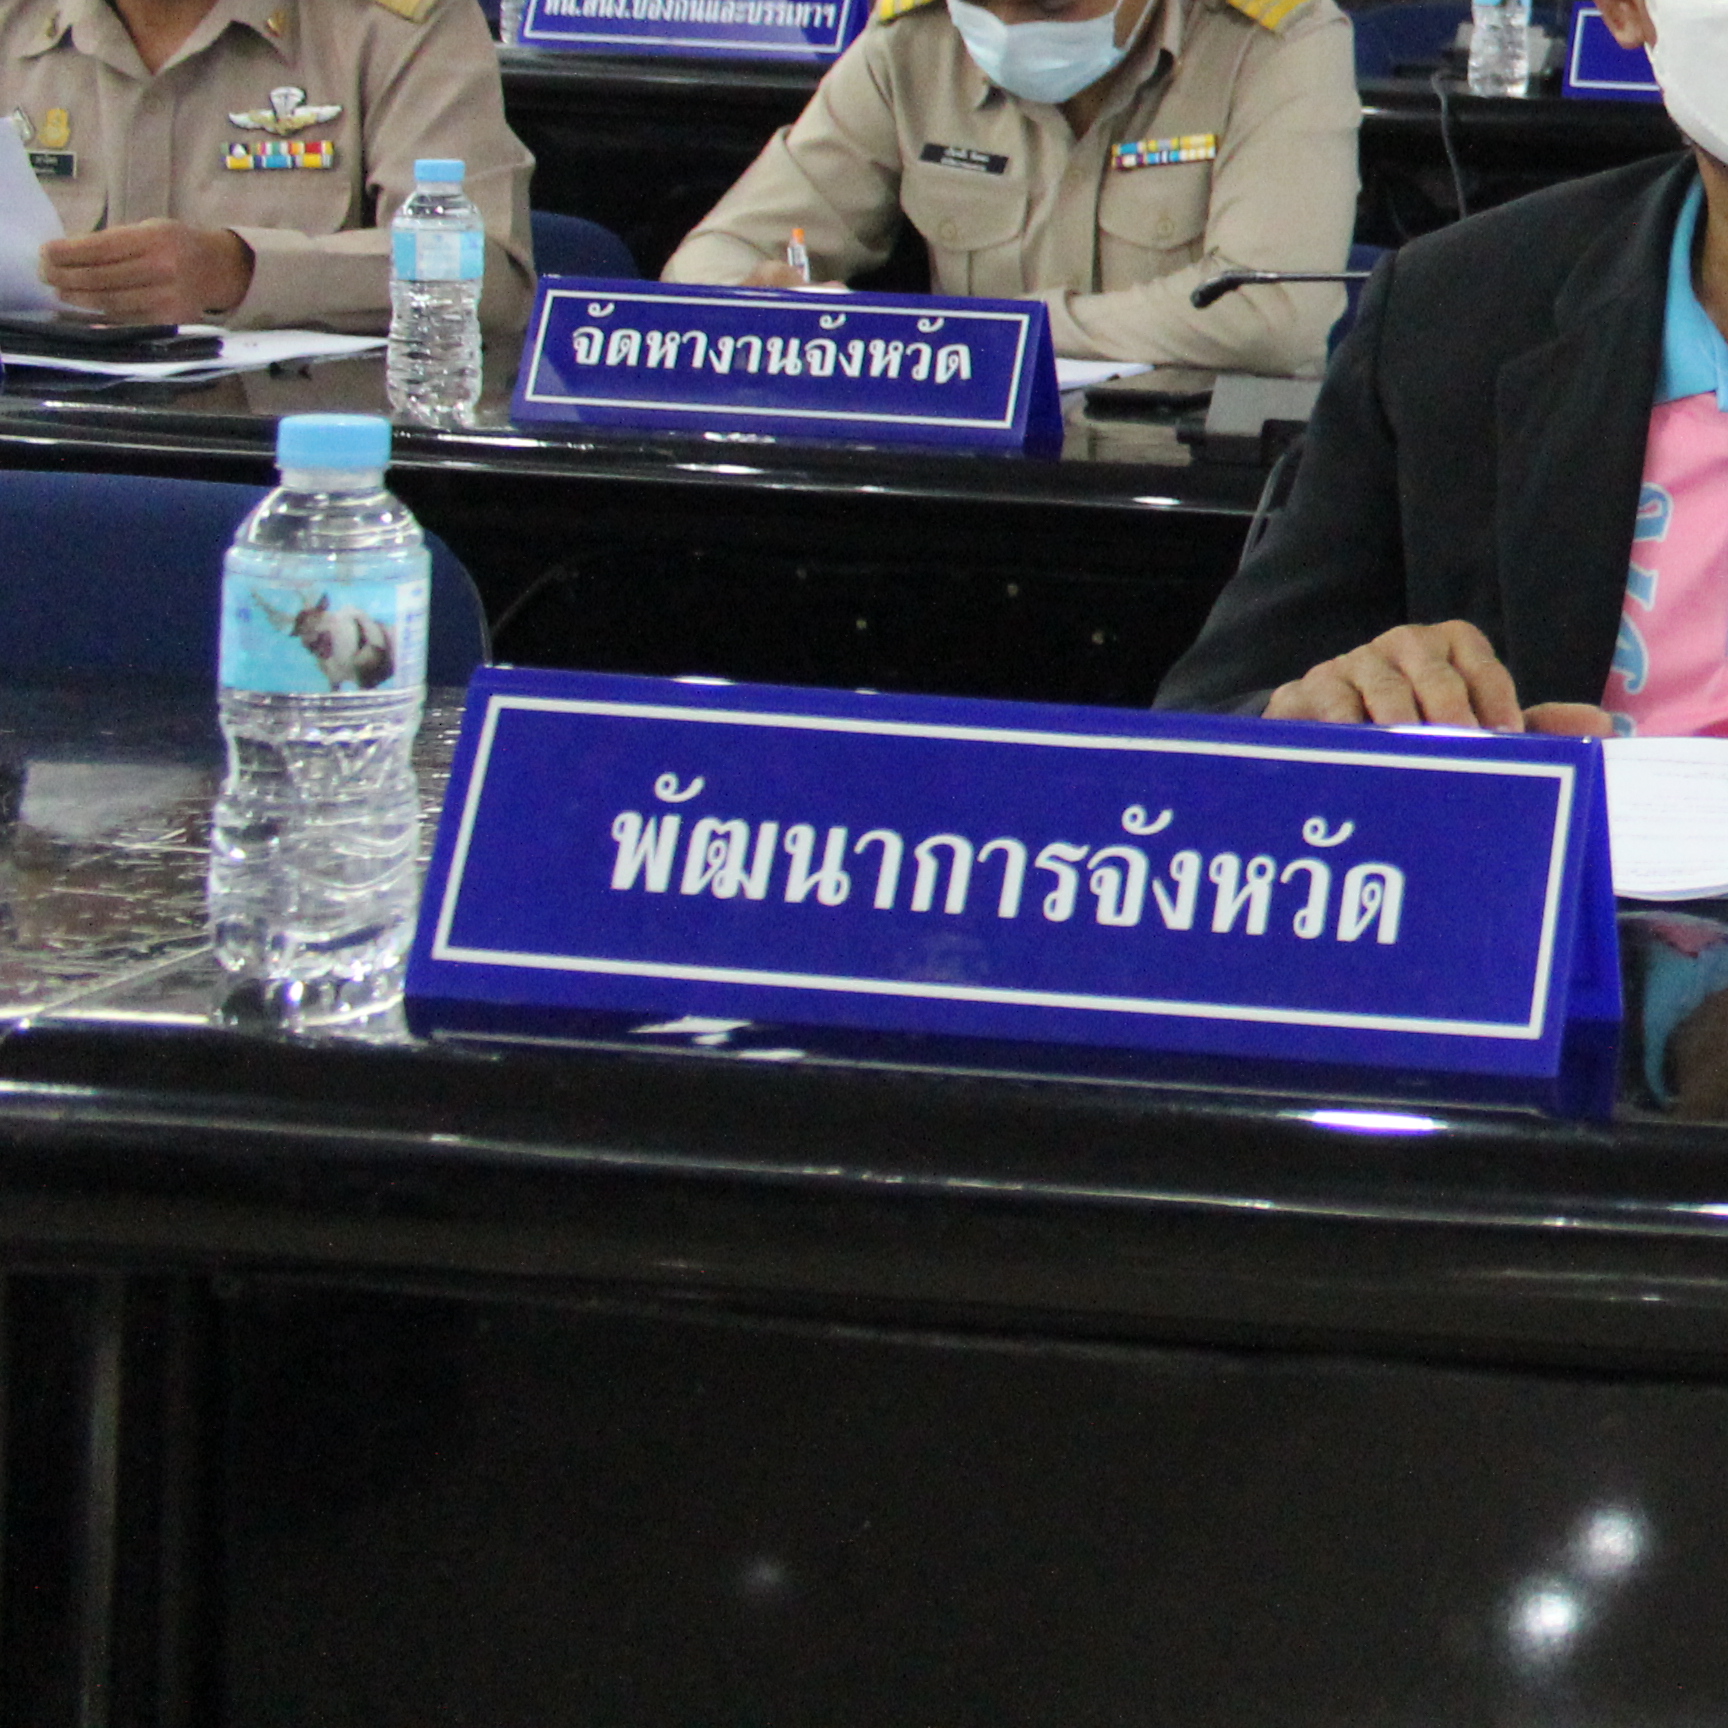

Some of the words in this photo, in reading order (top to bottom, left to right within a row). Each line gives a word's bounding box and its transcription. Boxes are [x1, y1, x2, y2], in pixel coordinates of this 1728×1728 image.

[572, 303, 972, 384] จัดหางานจังหวัด
[608, 772, 1405, 945] พัฒนาการจังหวัด
